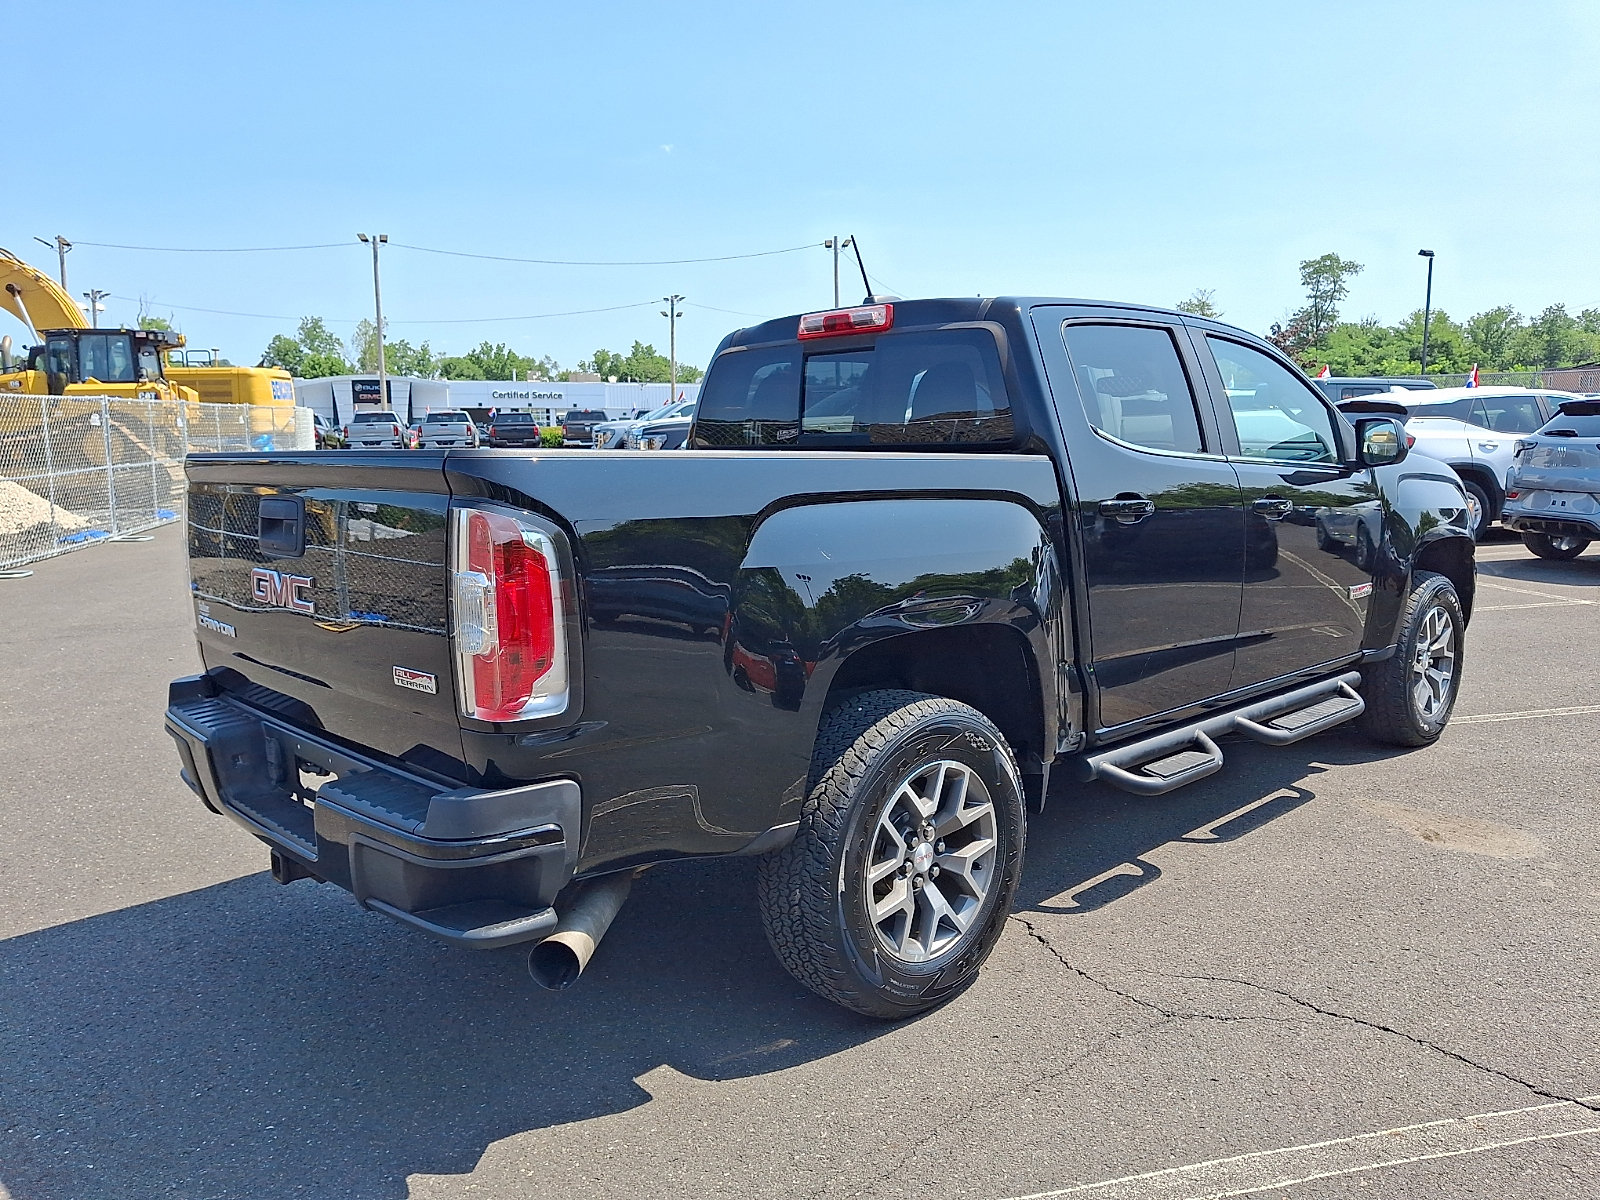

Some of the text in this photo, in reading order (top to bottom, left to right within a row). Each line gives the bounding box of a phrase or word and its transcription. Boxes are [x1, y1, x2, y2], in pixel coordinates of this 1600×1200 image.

[492, 391, 563, 399] Certified Service
[251, 567, 315, 614] GMC
[395, 669, 412, 679] ALL
[395, 677, 434, 692] TERRAIN
